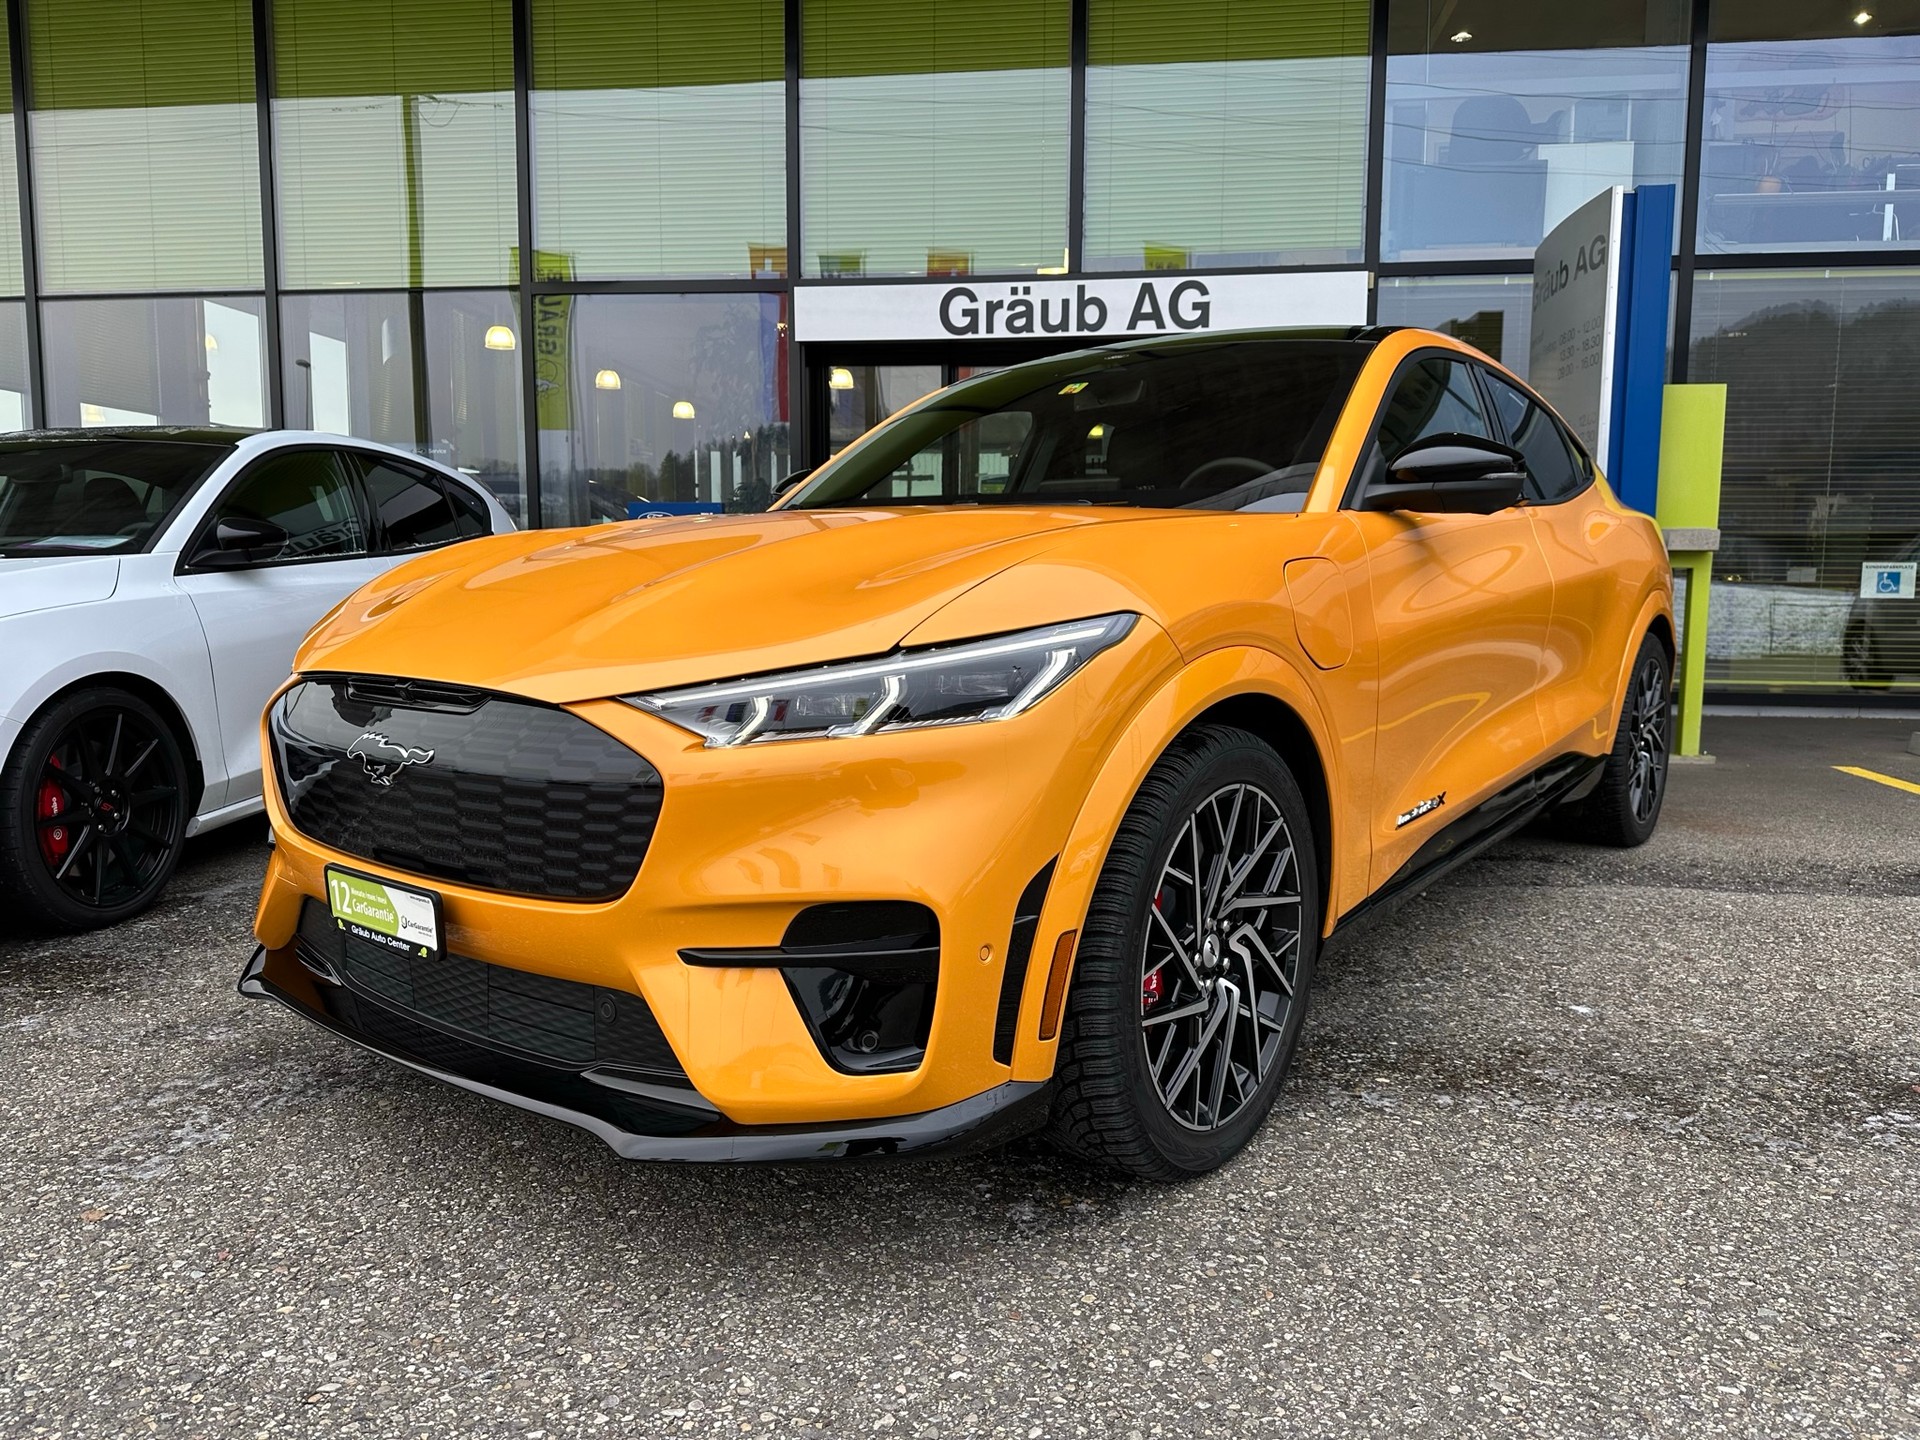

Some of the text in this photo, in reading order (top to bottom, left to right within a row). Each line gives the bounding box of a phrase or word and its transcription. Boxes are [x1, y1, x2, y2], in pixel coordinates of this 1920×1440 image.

[1574, 234, 1606, 281] AG
[939, 280, 1211, 336] Gräub AG
[331, 879, 352, 915] 12
[351, 925, 411, 952] Gräub Auto Center
